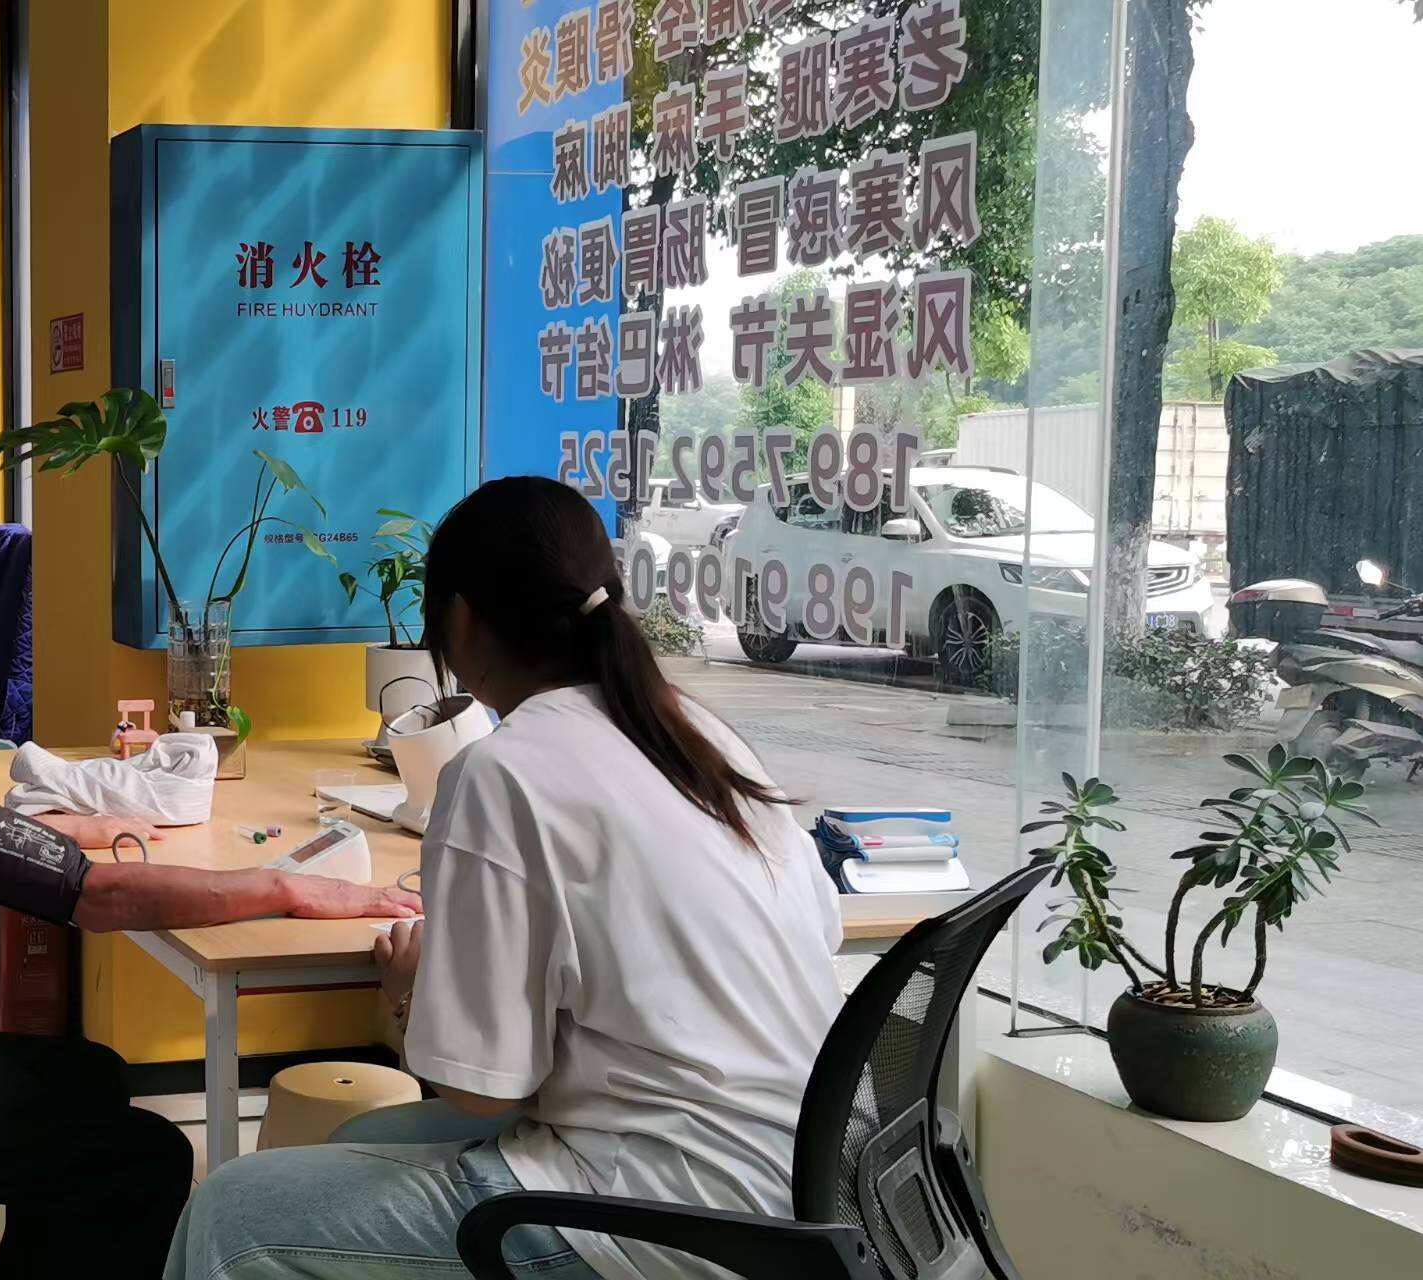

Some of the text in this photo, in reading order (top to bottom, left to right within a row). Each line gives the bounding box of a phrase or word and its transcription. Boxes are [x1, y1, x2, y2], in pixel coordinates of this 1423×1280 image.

[236, 241, 382, 289] 消火栓
[237, 302, 380, 318] FIRE HUYDRANT
[252, 406, 368, 432] 火警 119
